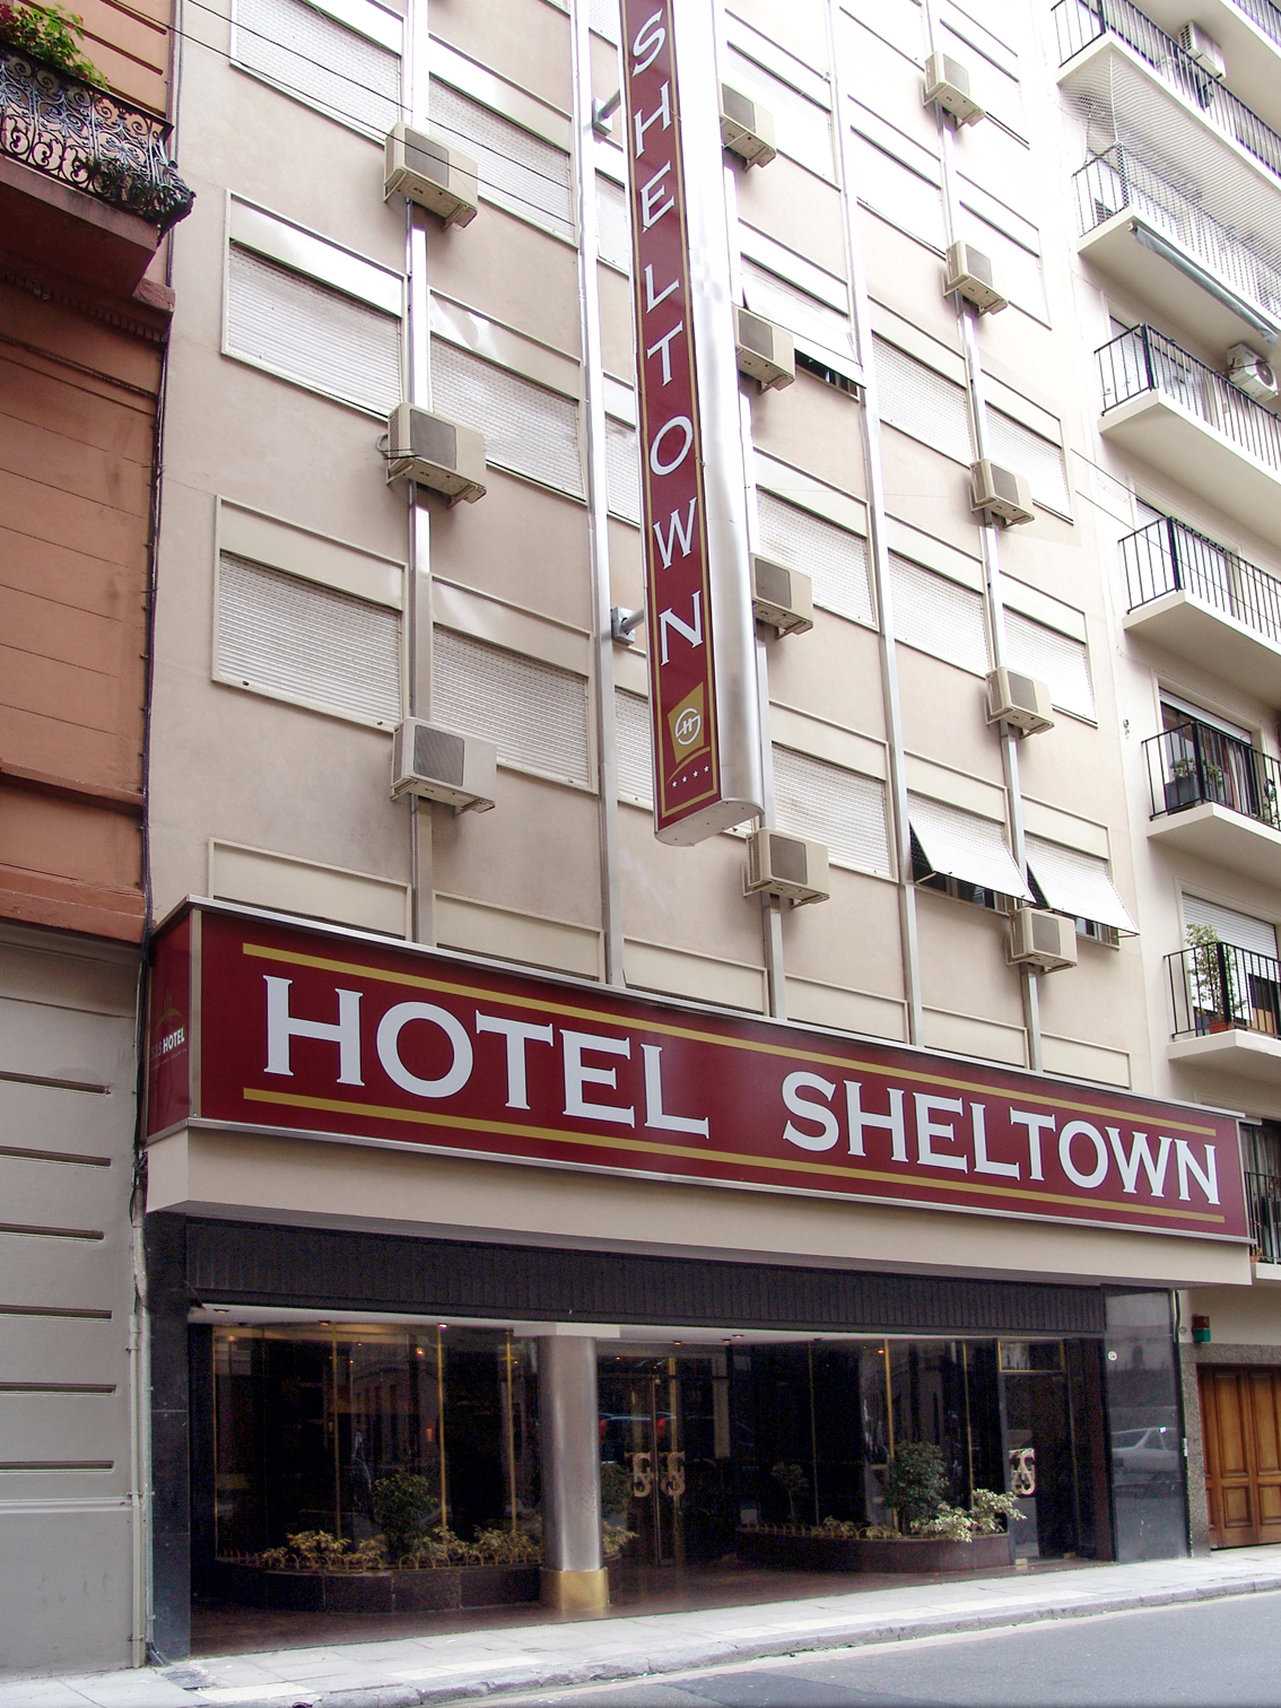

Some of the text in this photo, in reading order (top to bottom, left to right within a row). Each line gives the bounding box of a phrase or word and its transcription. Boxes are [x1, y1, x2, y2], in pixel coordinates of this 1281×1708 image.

[632, 8, 704, 666] SHELTOWN
[162, 1025, 185, 1054] HOTEL
[262, 975, 1221, 1205] HOTEL SHELTOWN
